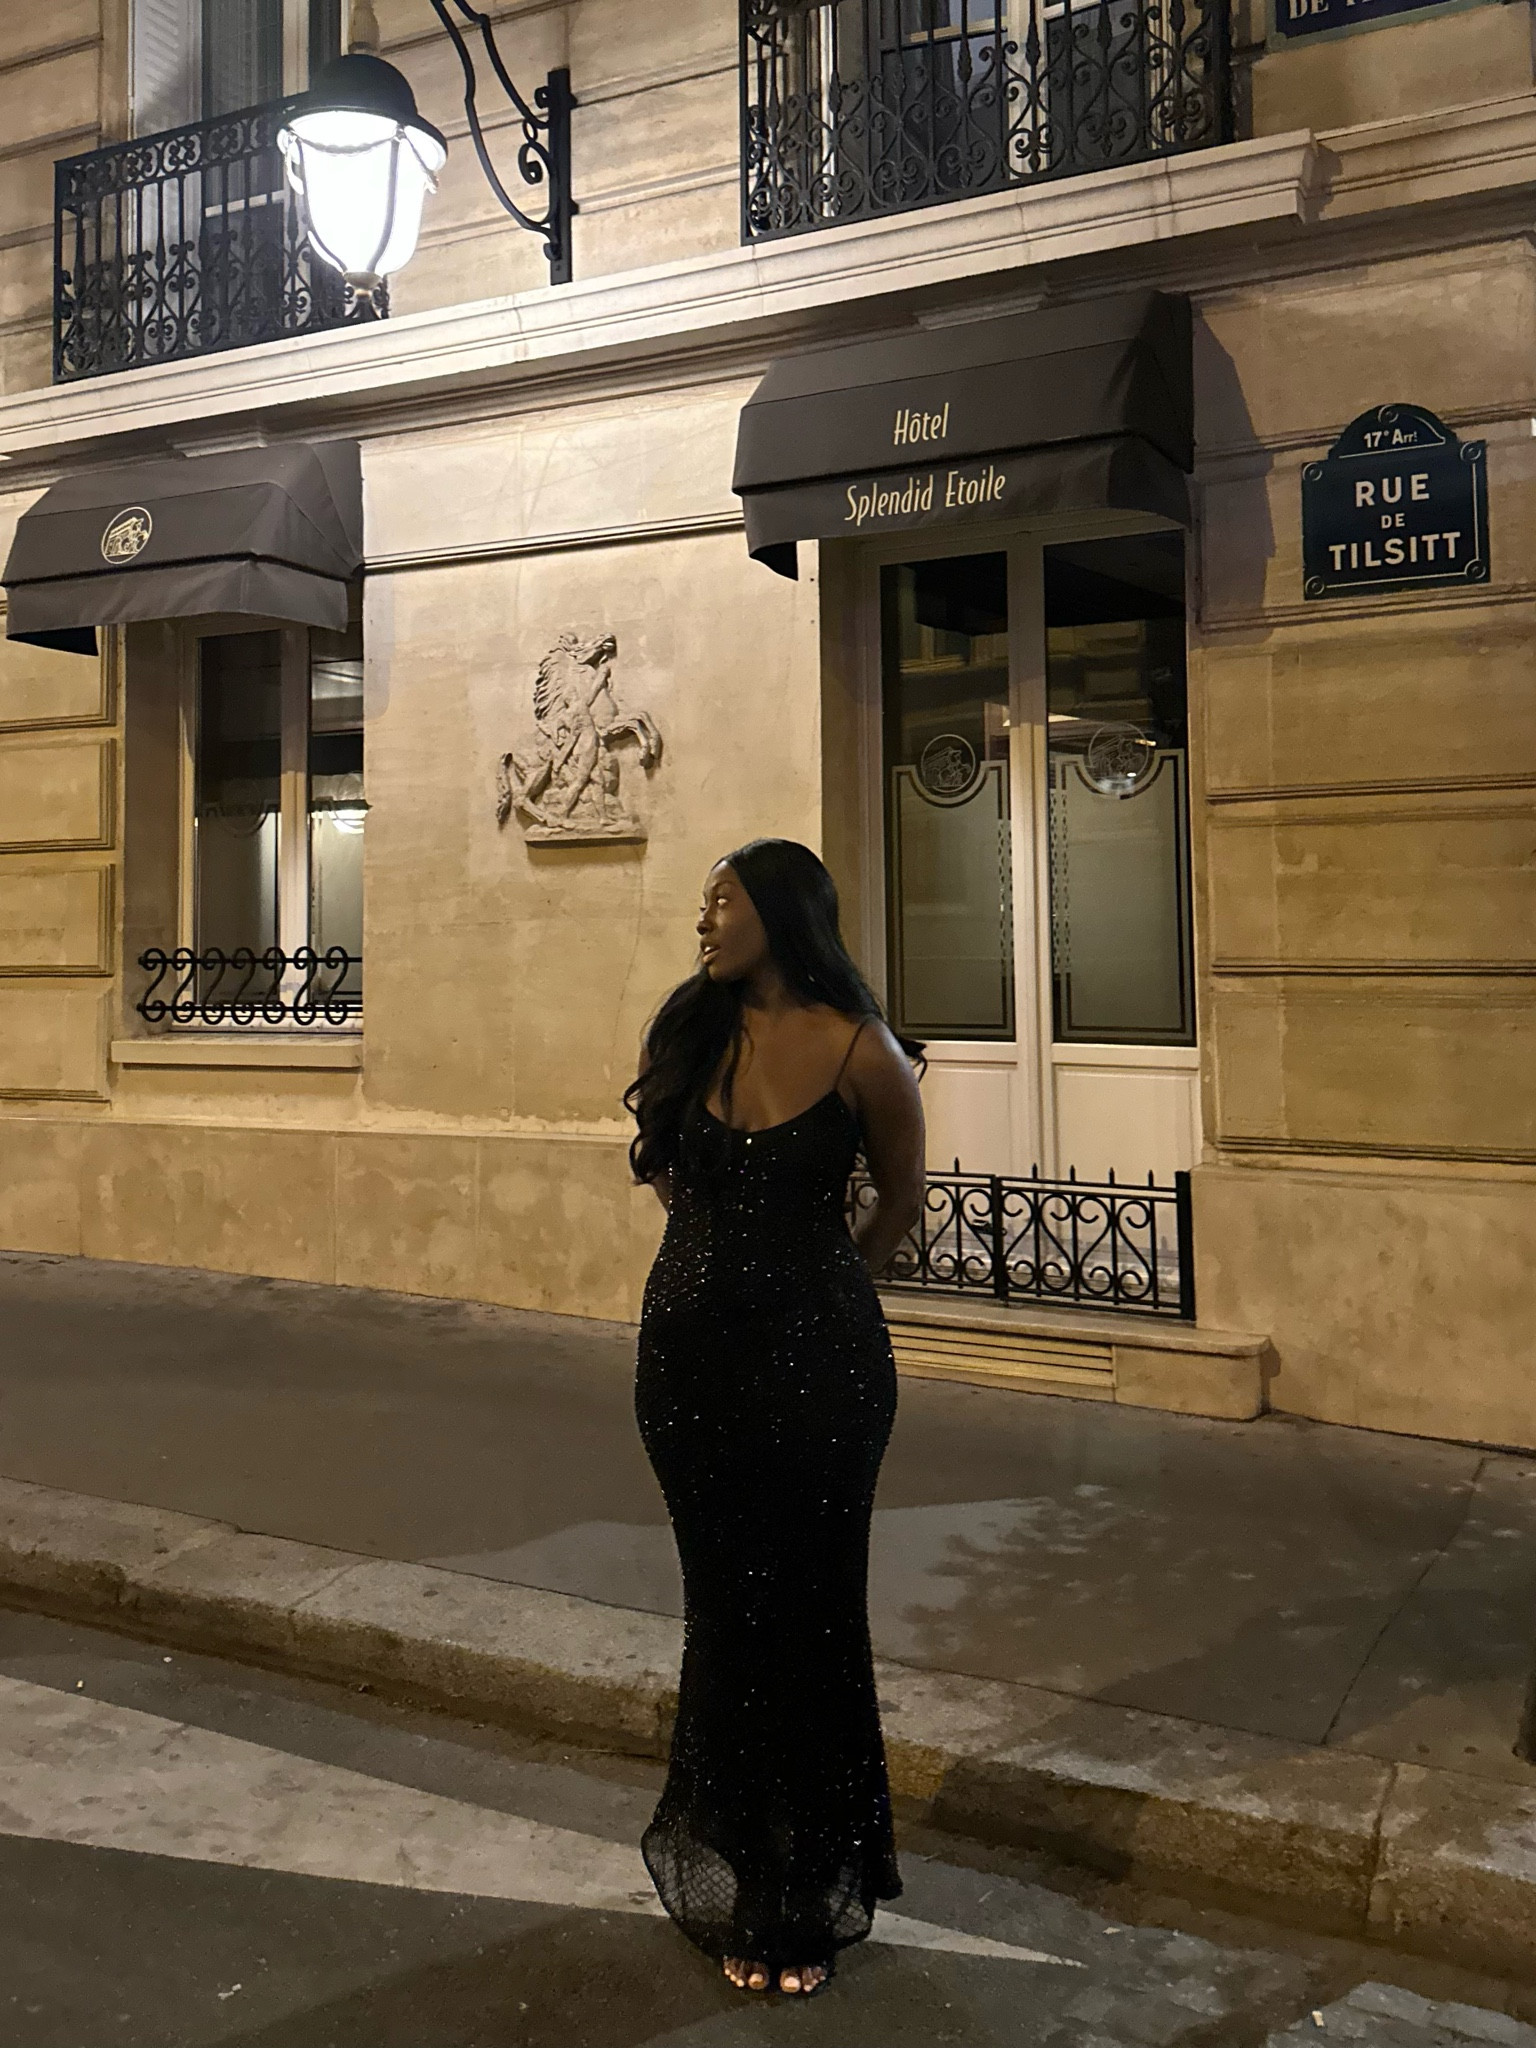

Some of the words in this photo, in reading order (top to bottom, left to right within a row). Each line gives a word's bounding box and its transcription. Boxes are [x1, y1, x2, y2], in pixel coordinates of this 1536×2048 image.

[893, 402, 949, 445] Hôtel
[844, 474, 933, 526] Splendid
[945, 465, 1006, 507] Etoile
[1355, 473, 1430, 507] RUE
[1381, 513, 1405, 529] DE
[1329, 532, 1461, 570] TILSITT
